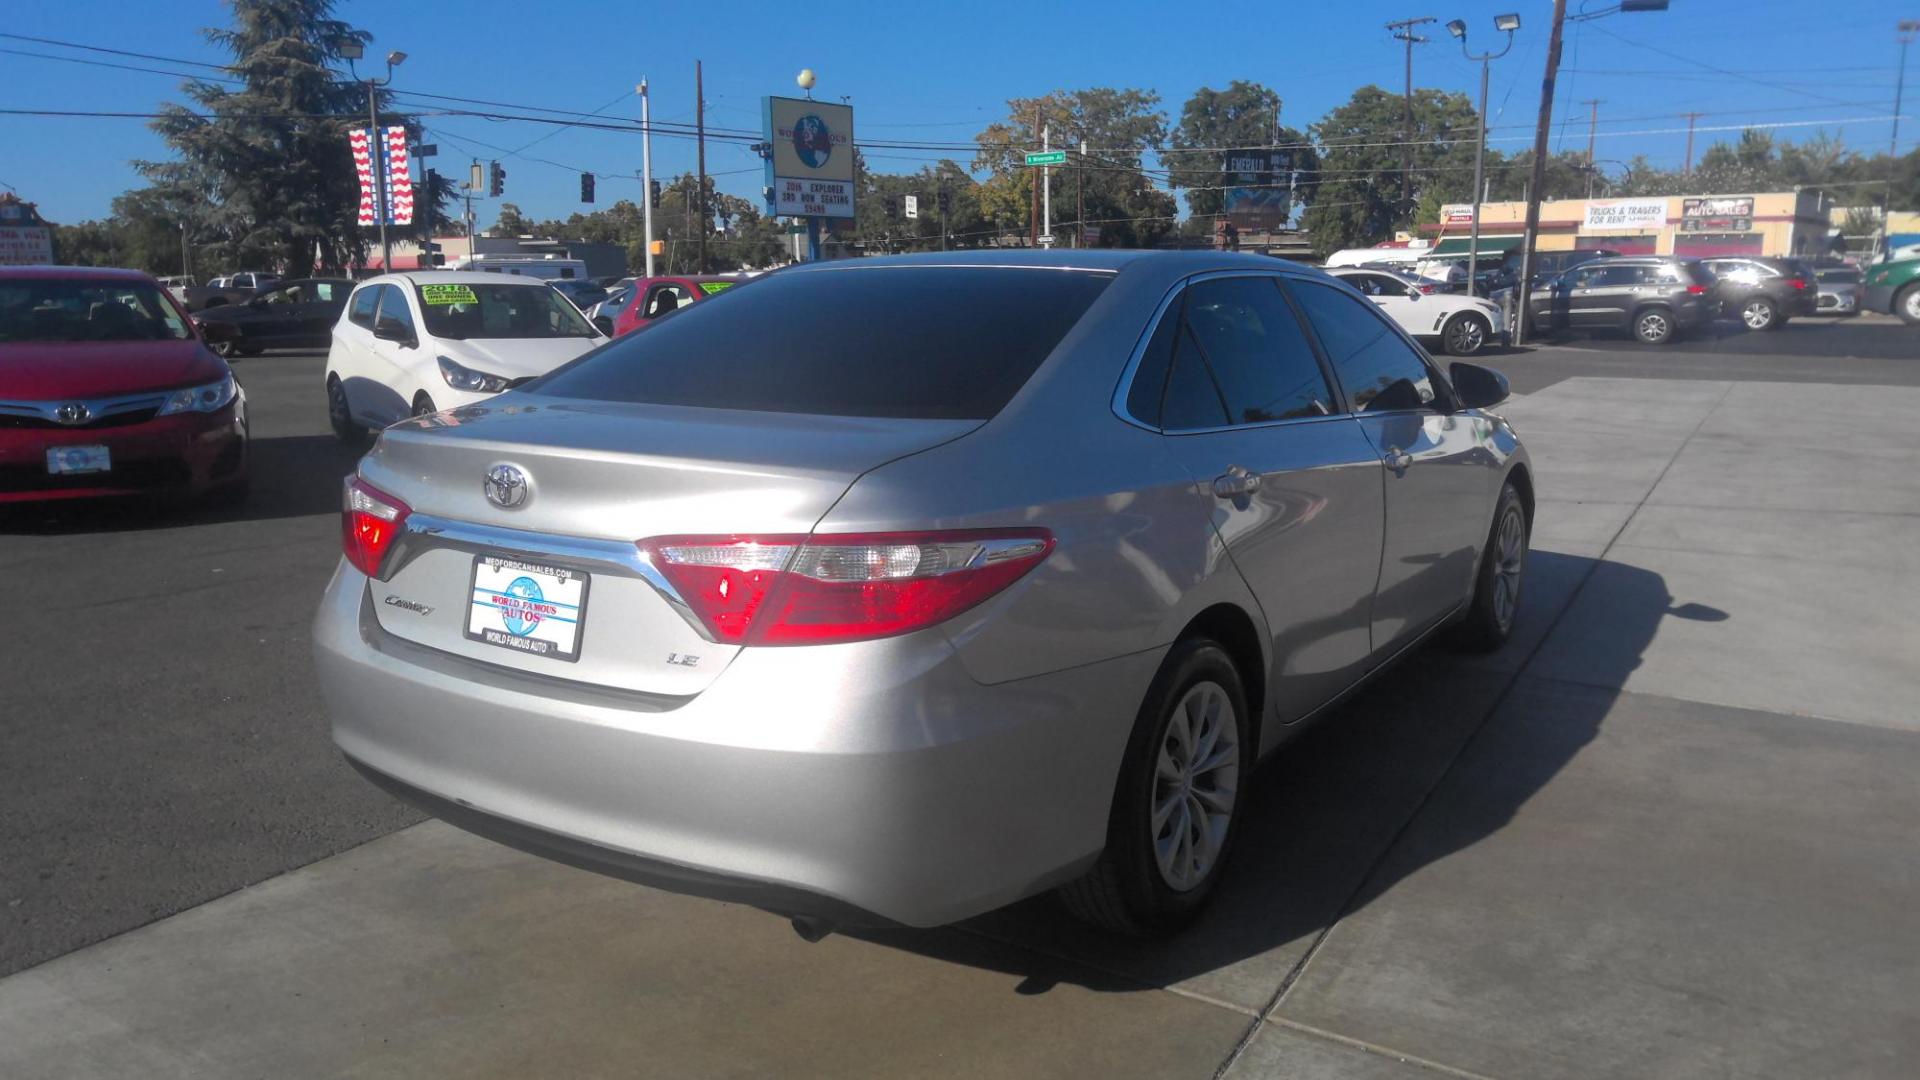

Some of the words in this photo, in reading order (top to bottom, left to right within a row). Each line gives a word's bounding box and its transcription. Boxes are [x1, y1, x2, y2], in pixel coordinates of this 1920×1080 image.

[810, 183, 844, 194] EXPLORER
[820, 194, 849, 205] SEATING
[1590, 207, 1617, 216] TRUCKS
[1619, 207, 1626, 215] &
[1687, 206, 1713, 216] AUTO
[1715, 205, 1749, 216] SALES
[1589, 216, 1604, 225] FOR
[1606, 216, 1626, 224] RENT
[491, 595, 520, 608] WORLD
[522, 601, 557, 615] FAMOUS
[503, 607, 541, 622] AUTOS
[486, 631, 507, 643] WORLD
[507, 634, 531, 649] FAMOUS
[530, 641, 548, 653] AUTO
[666, 652, 700, 667] LE
